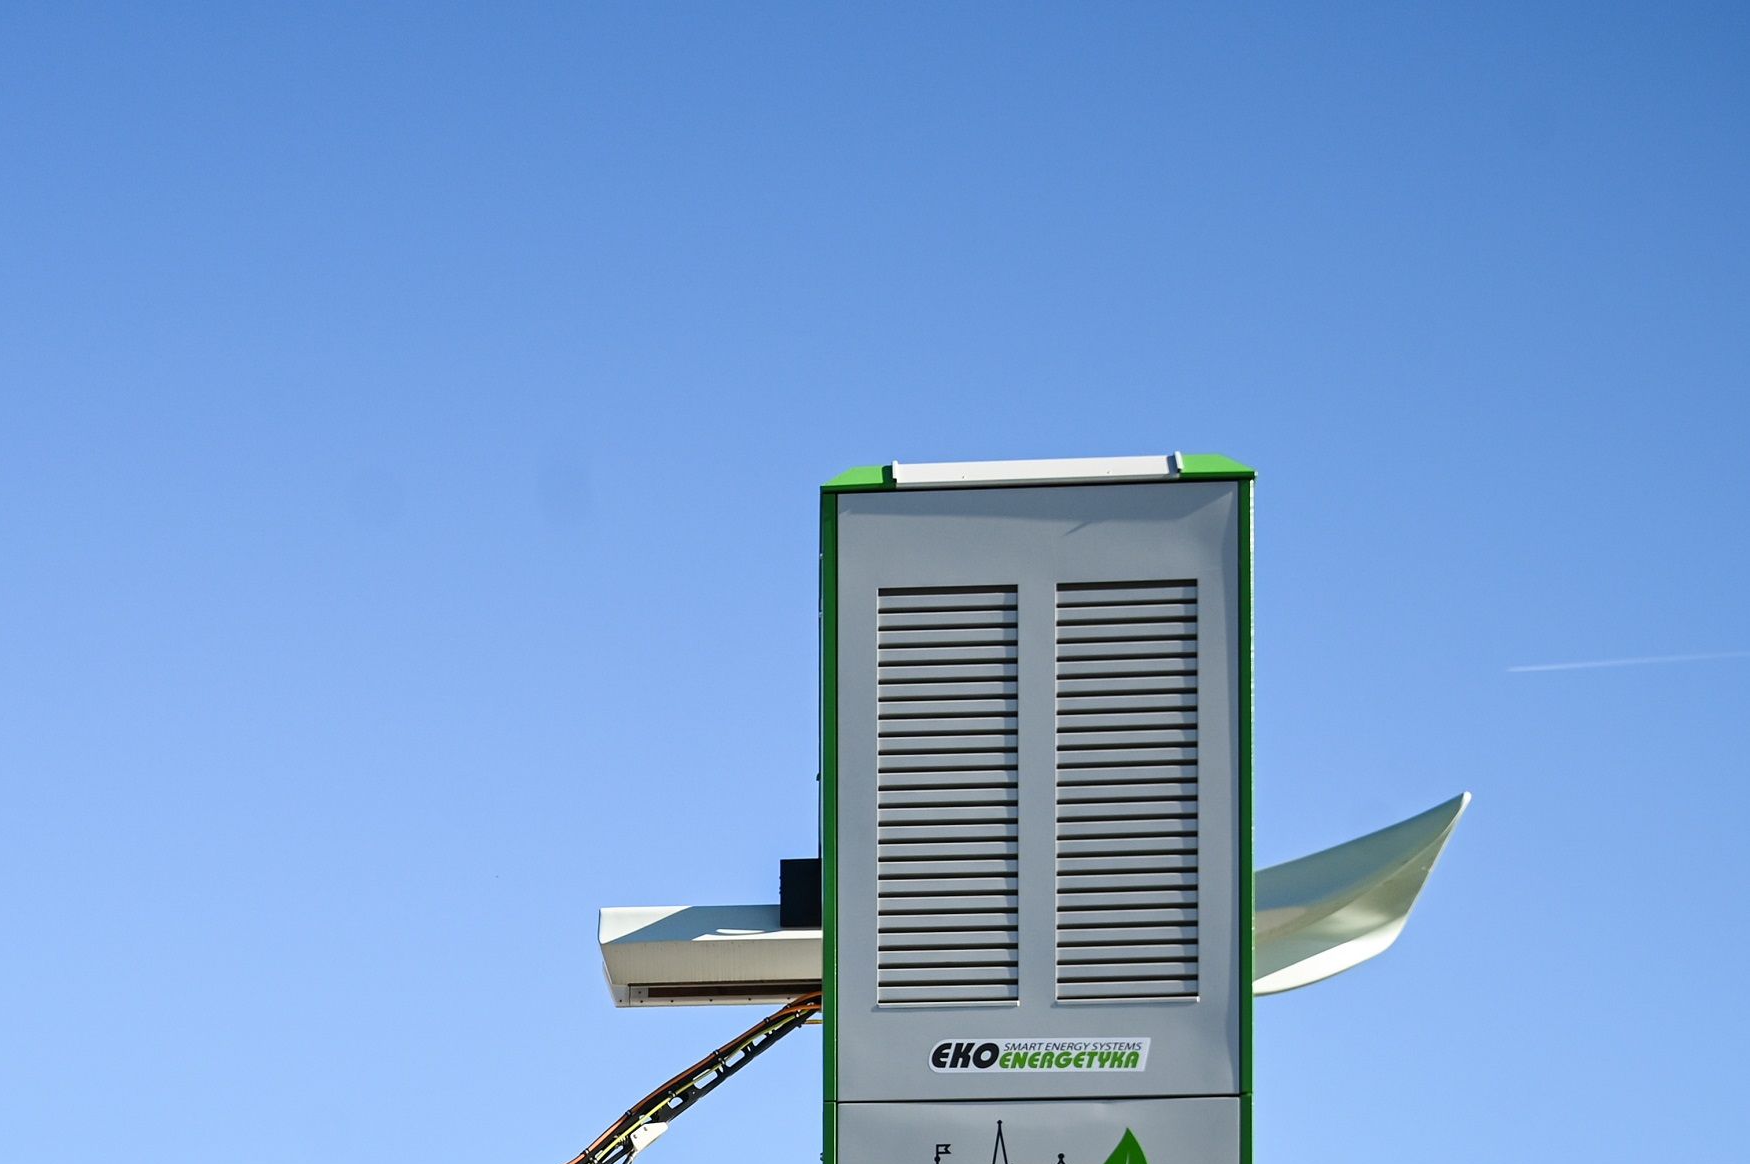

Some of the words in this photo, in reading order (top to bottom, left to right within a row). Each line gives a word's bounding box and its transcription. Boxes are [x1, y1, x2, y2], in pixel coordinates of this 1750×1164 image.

[931, 1042, 1000, 1069] EKO
[999, 1051, 1140, 1069] ENERGETYKA
[1003, 1042, 1044, 1051] SMART
[1045, 1042, 1092, 1051] ENERGY
[1091, 1042, 1142, 1051] SYSTEMS
